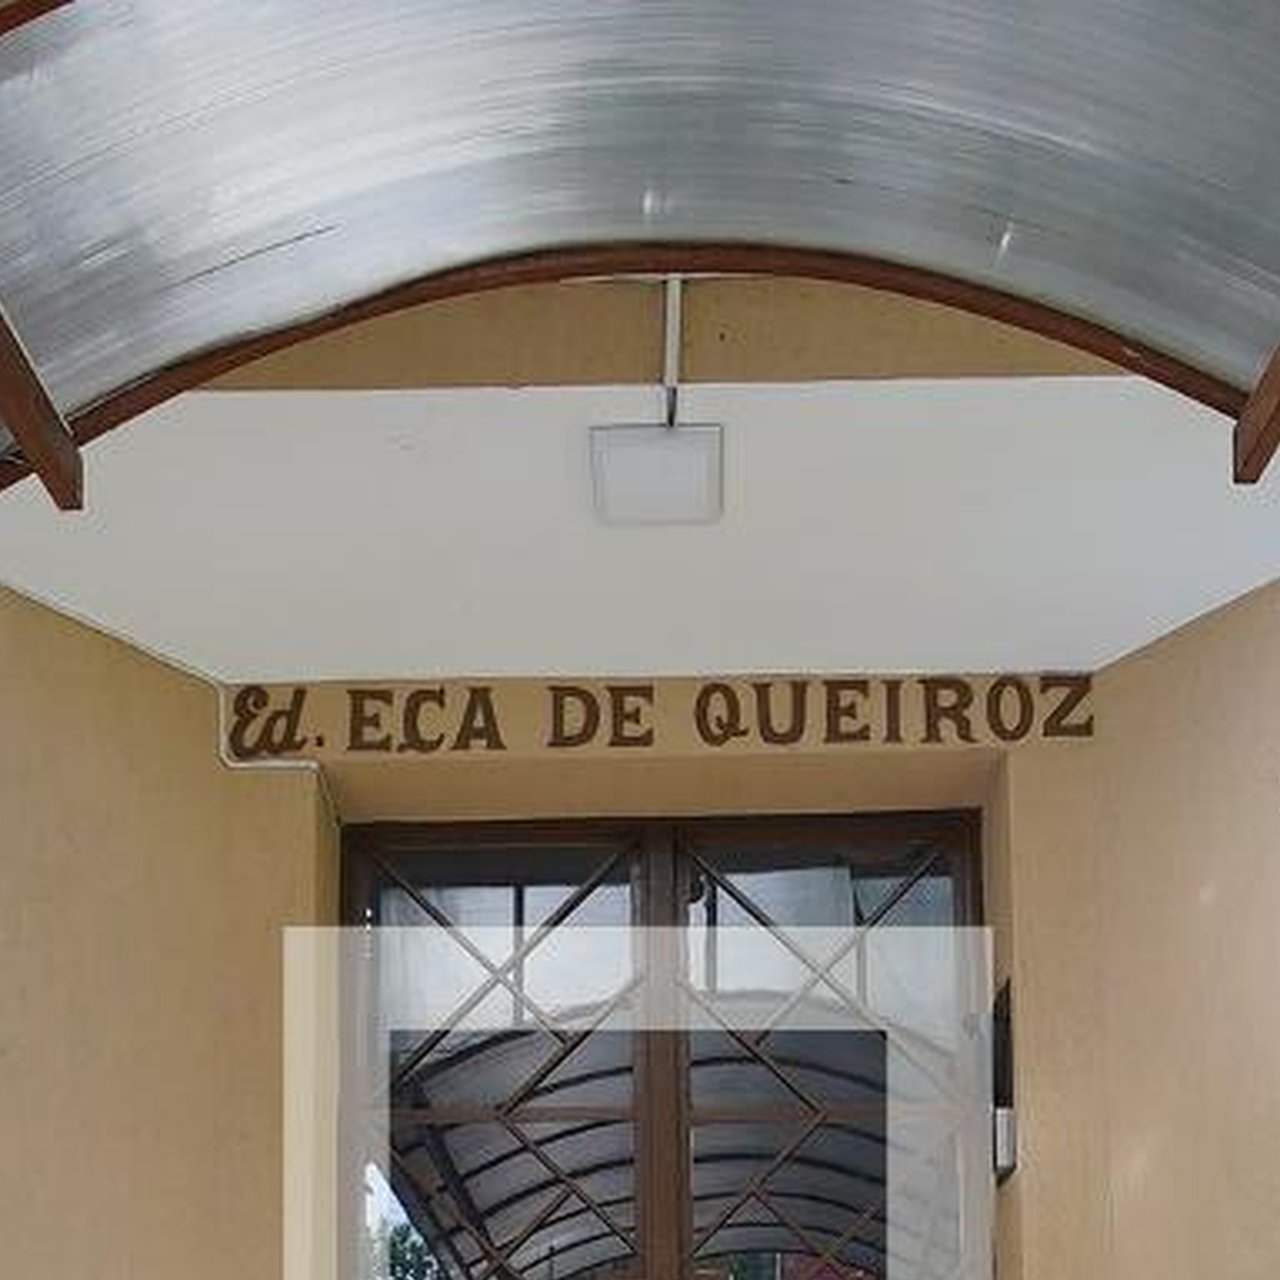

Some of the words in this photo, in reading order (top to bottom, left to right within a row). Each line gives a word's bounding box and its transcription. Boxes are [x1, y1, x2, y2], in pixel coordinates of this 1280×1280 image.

[228, 685, 324, 757] Ed.
[546, 684, 655, 747] DE
[694, 674, 1095, 747] QUEIROZ
